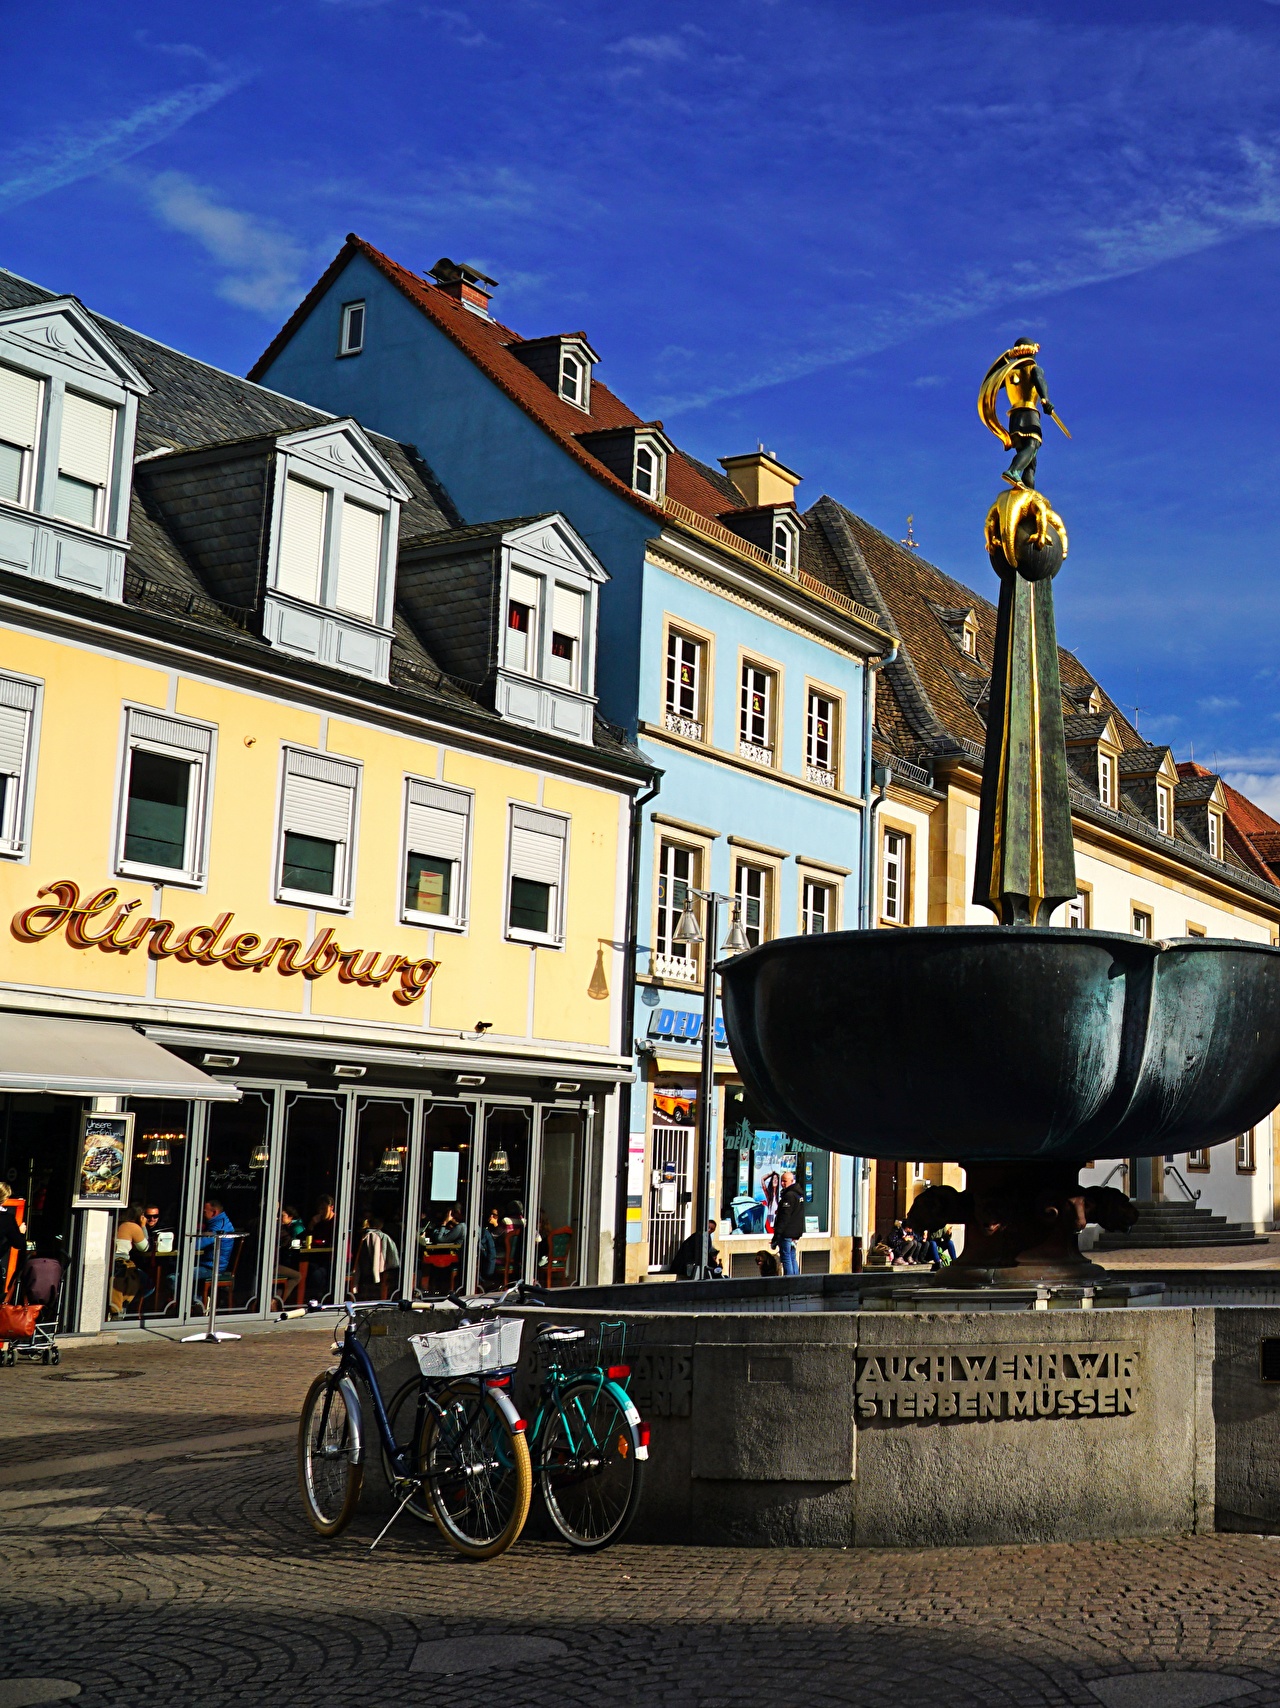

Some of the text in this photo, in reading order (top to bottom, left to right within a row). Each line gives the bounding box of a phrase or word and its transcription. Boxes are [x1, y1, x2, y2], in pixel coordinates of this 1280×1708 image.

[10, 880, 441, 1006] Hindenburg
[657, 1008, 726, 1042] DEUS
[858, 1352, 1140, 1383] AUCH WENN WIR
[858, 1383, 1138, 1418] STERBEN MÜSSEN
